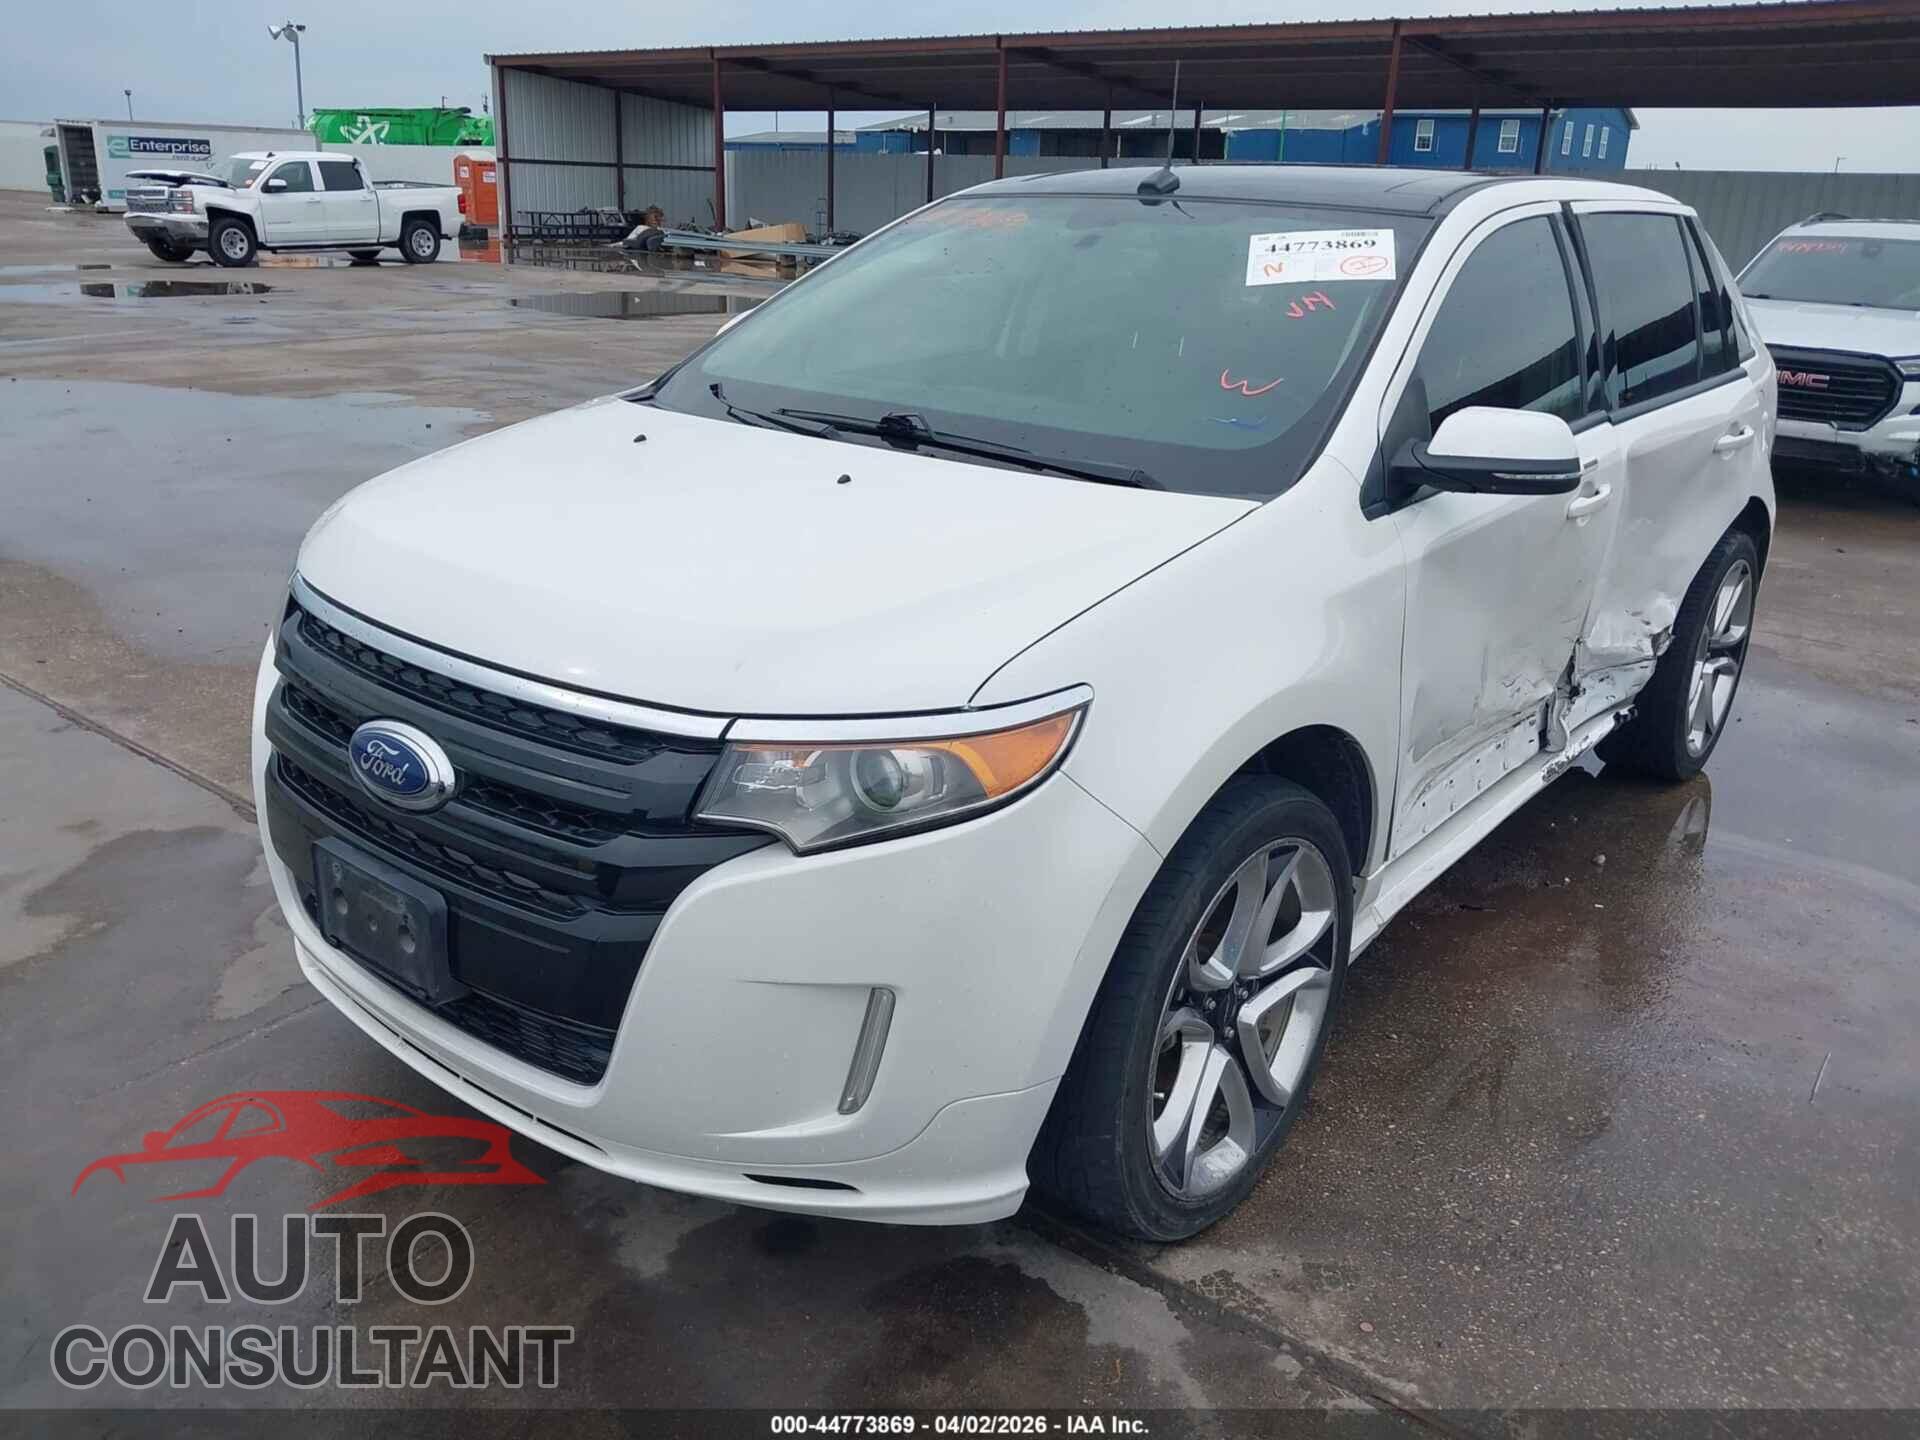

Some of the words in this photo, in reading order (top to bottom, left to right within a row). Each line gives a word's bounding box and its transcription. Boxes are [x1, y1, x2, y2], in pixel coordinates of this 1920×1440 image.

[130, 139, 210, 154] Enterprise
[1265, 239, 1377, 253] 44773869
[1776, 369, 1830, 388] MC
[360, 739, 410, 785] Ford
